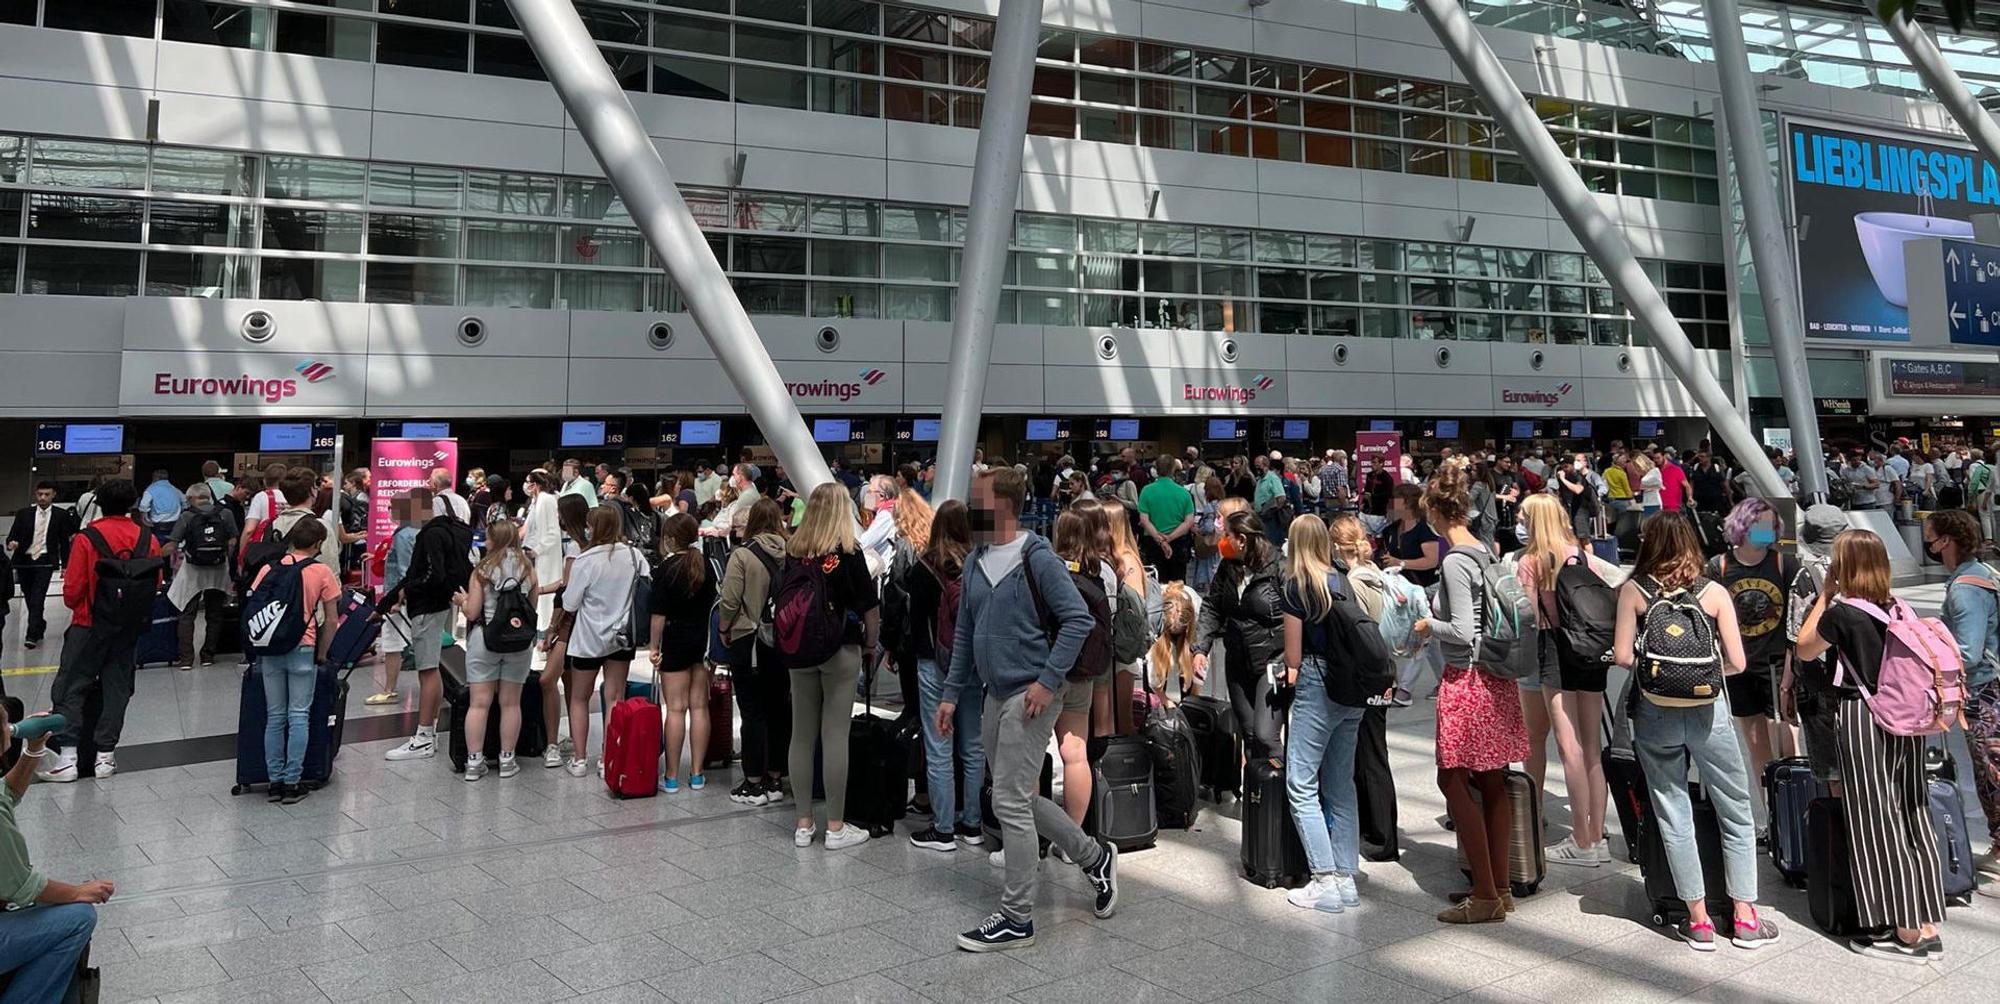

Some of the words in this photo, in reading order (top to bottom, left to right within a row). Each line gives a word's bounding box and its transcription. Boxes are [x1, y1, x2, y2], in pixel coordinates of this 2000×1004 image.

[1987, 261, 2000, 277] Ch
[1907, 362, 1929, 374] Gates
[1930, 363, 1952, 375] A,B,C
[154, 373, 296, 402] Eurowings
[785, 379, 861, 401] rowings
[1184, 384, 1256, 405] Eurowings
[1503, 390, 1559, 407] Eurowings
[607, 434, 623, 443] 163
[661, 433, 678, 442] 162
[1057, 430, 1069, 438] 159
[1236, 429, 1247, 437] 157
[38, 440, 62, 451] 166
[314, 438, 334, 447] 165
[1360, 444, 1389, 453] Eurowings
[378, 457, 435, 469] Eurowings
[377, 479, 431, 488] ERFORDERLIC
[247, 600, 282, 638] NIKE
